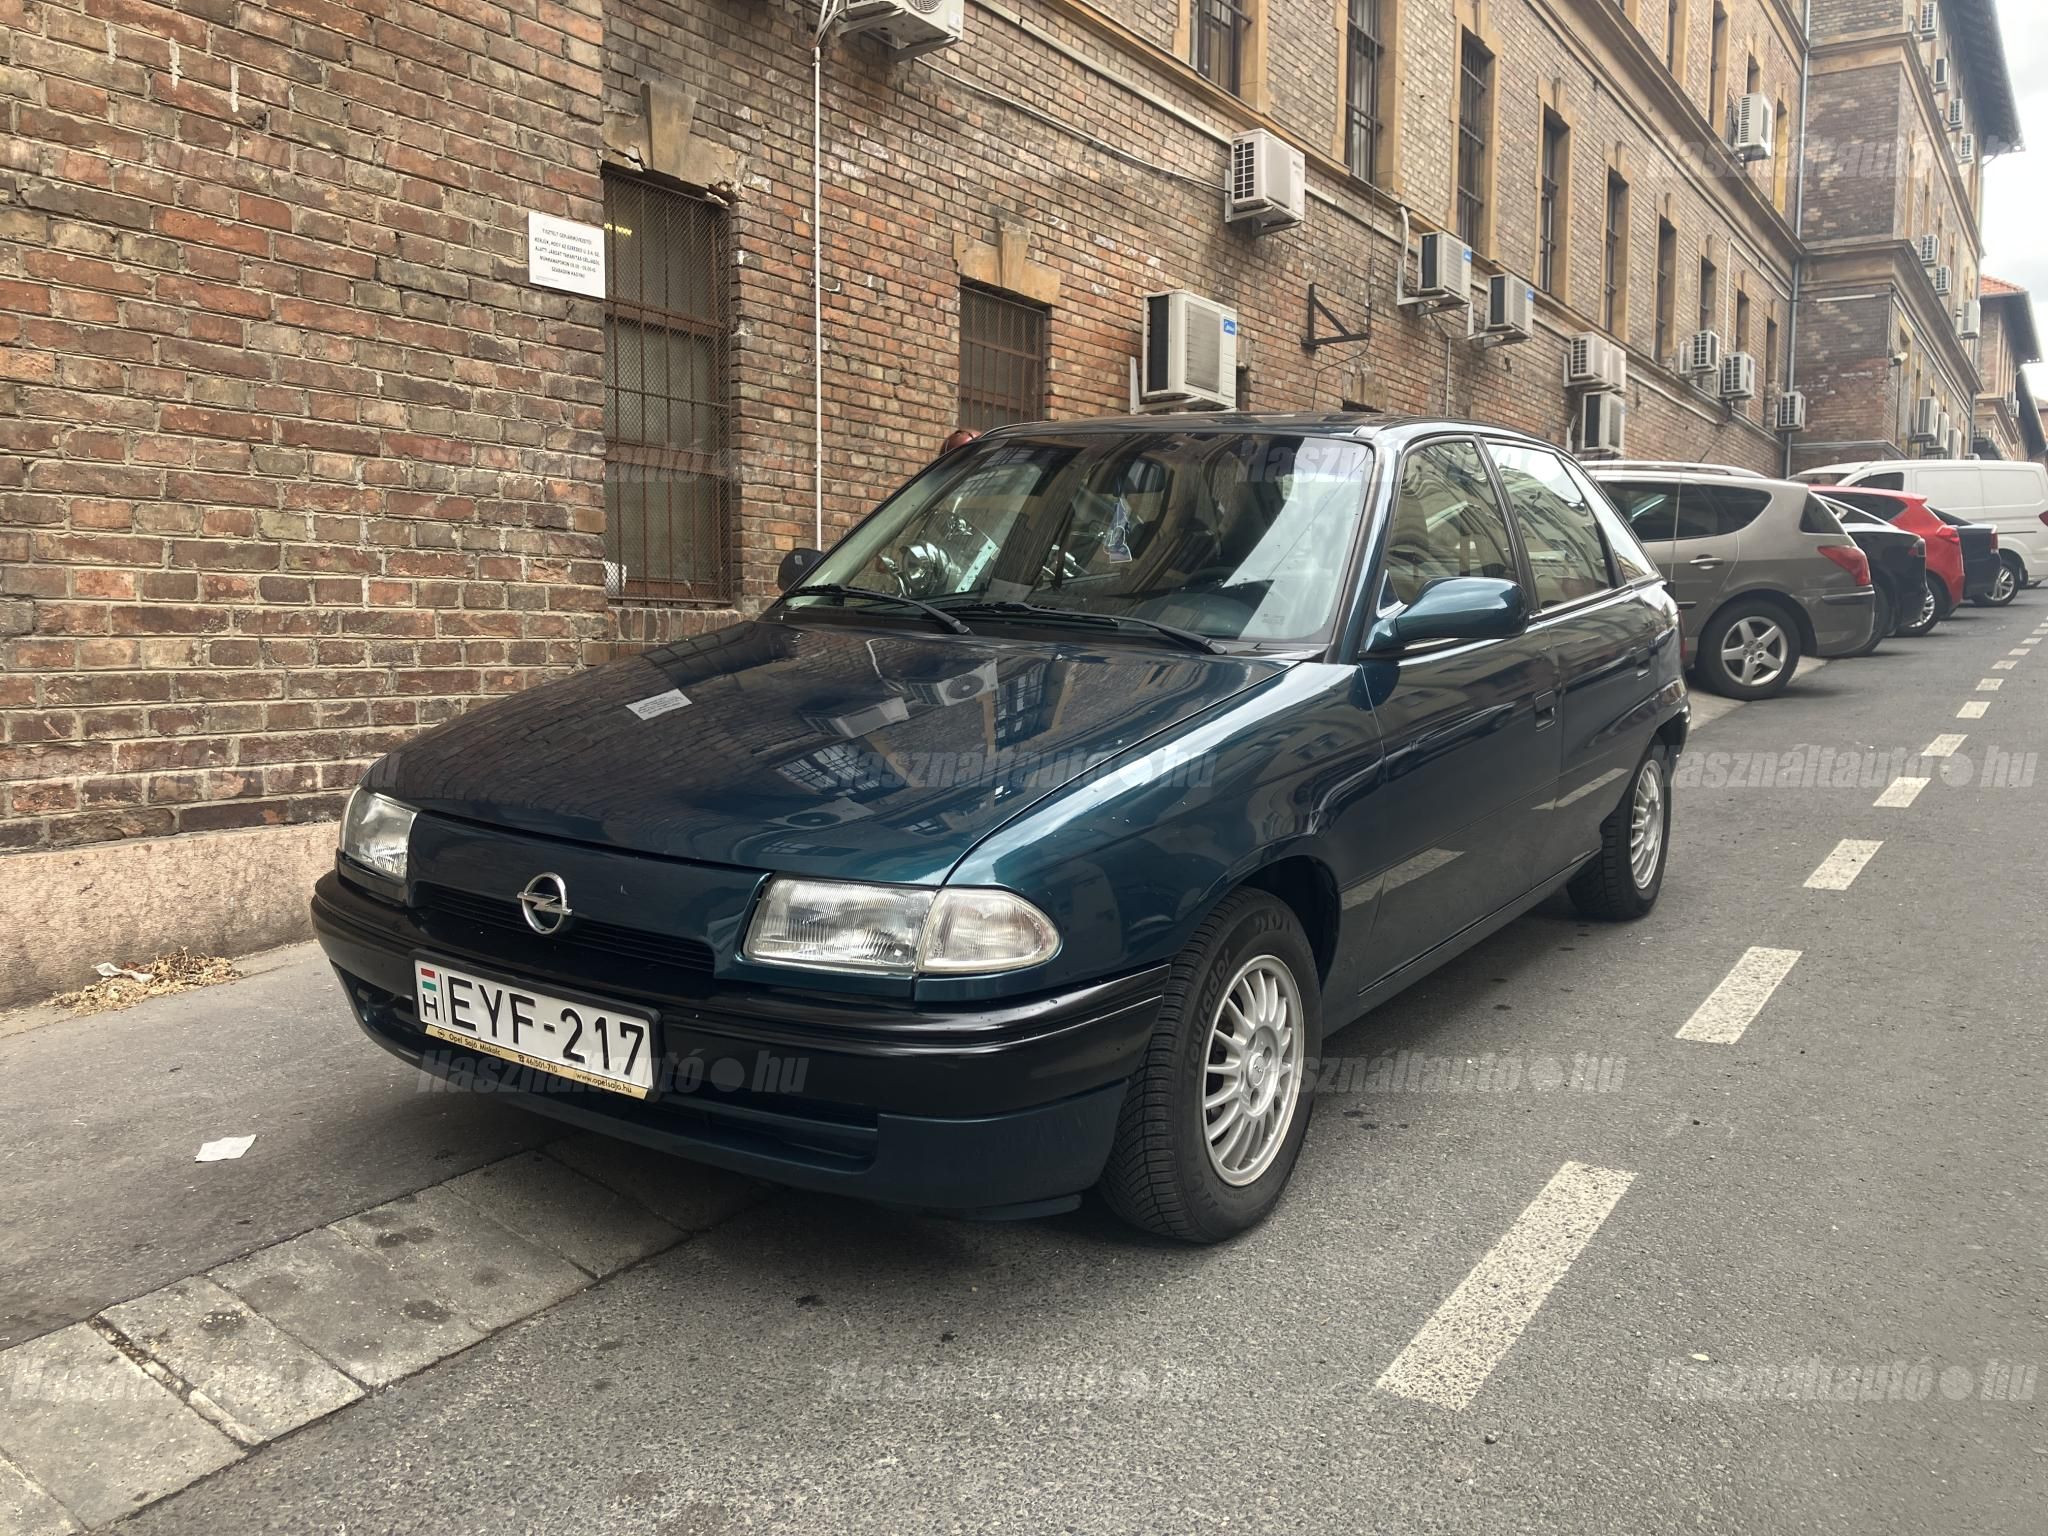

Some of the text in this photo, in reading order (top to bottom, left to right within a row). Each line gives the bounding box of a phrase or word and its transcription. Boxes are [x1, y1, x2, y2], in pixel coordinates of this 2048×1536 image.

[422, 991, 439, 1020] H
[448, 975, 644, 1076] EYF-217
[449, 1033, 463, 1043] Opel
